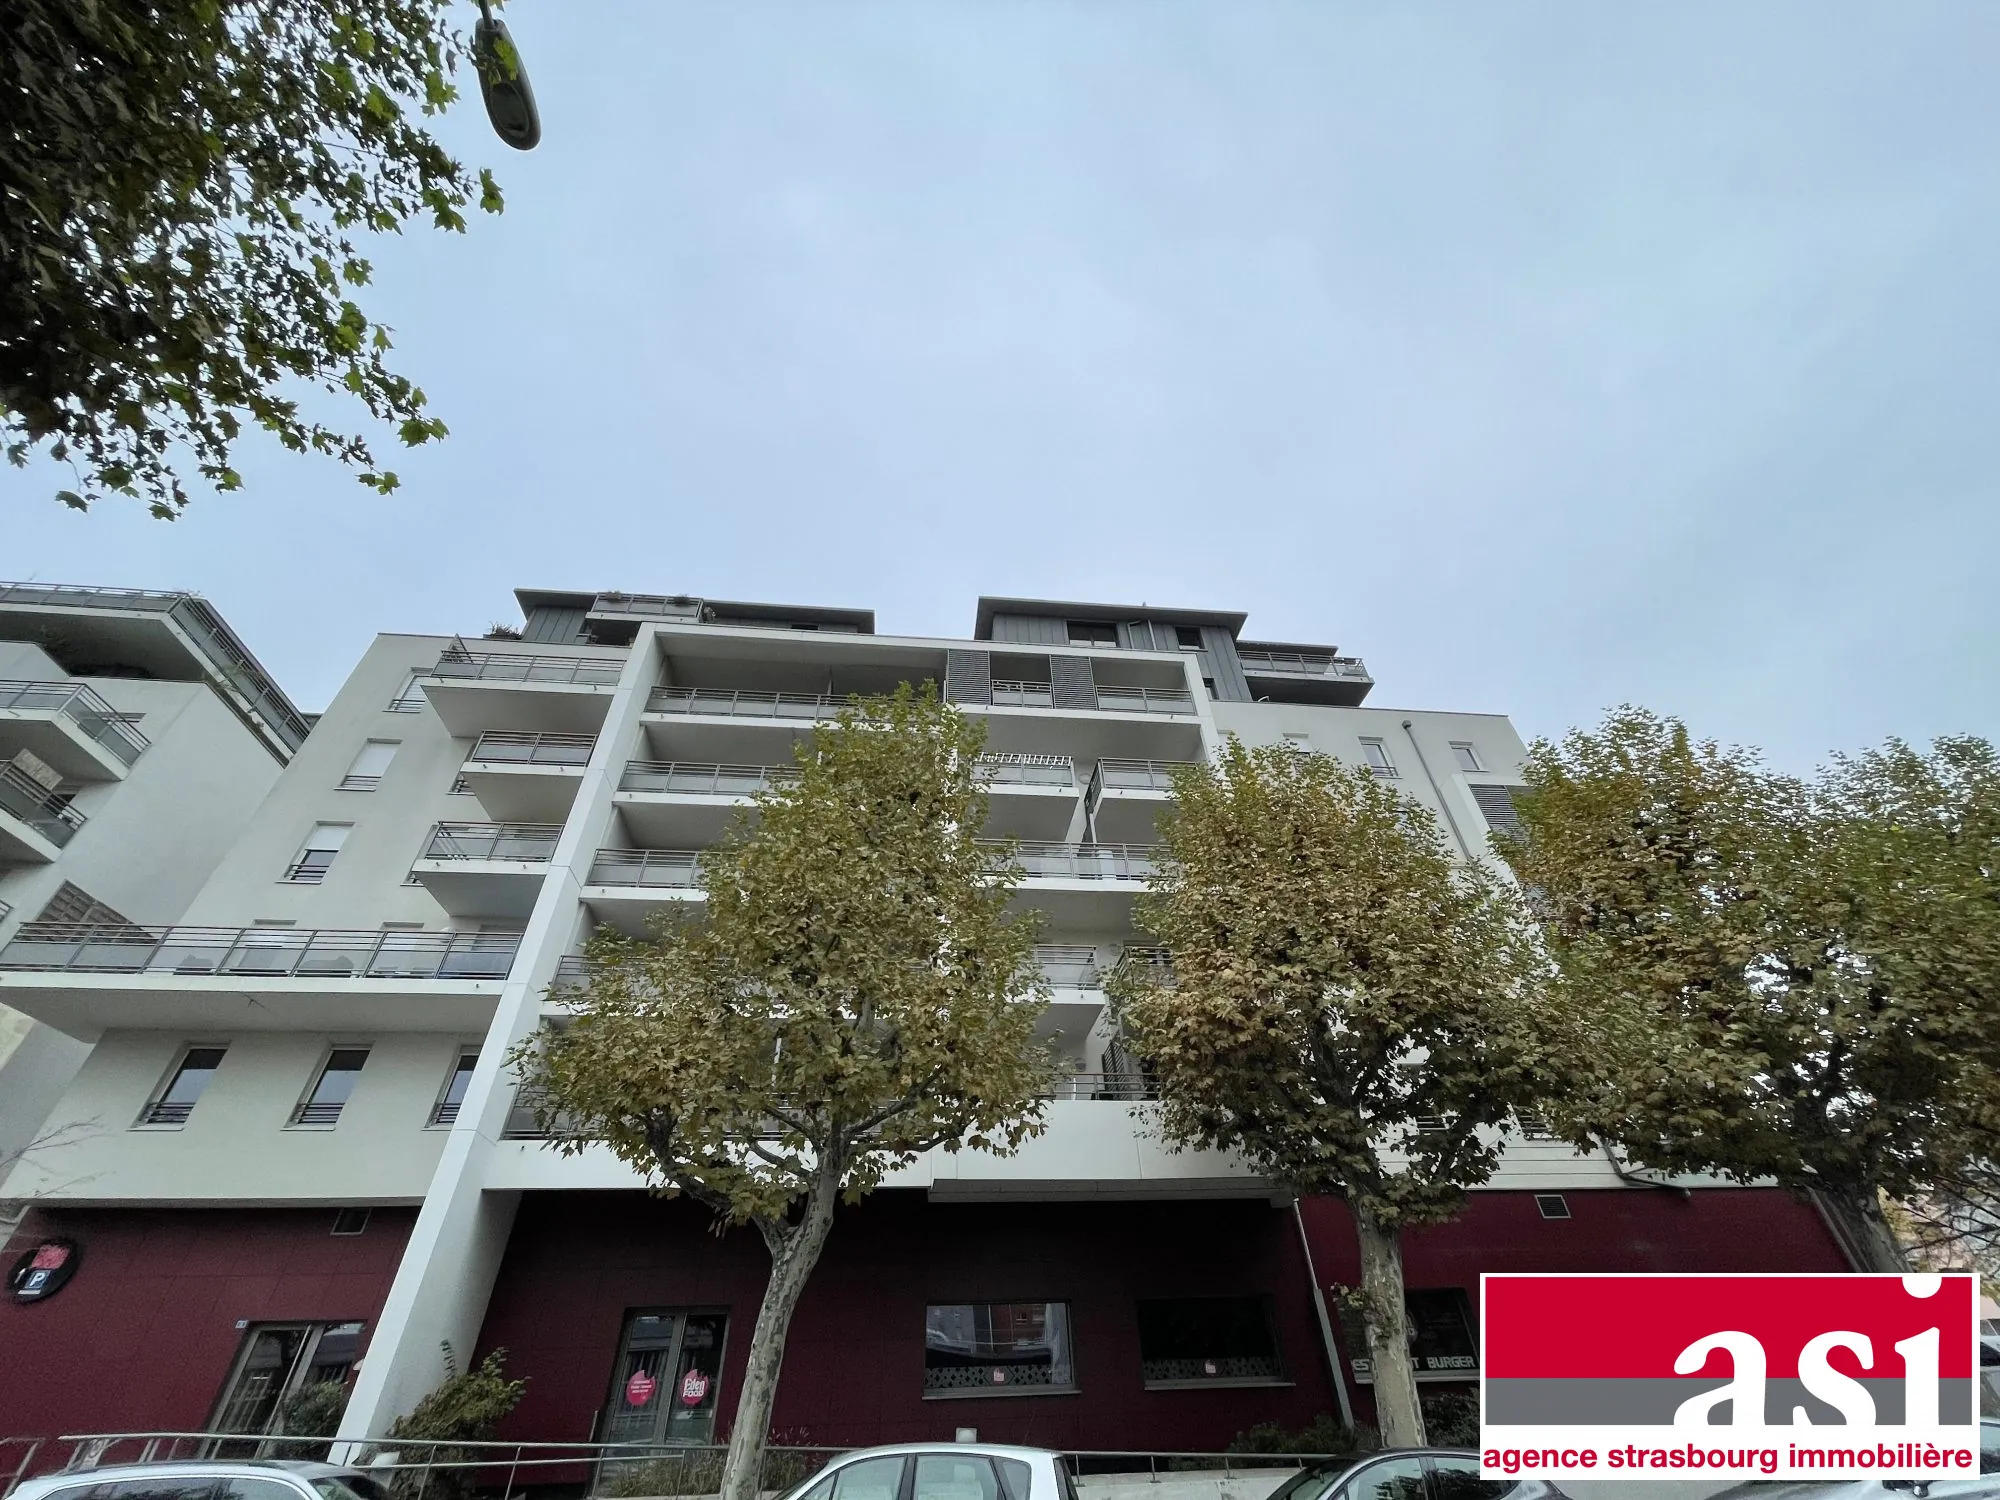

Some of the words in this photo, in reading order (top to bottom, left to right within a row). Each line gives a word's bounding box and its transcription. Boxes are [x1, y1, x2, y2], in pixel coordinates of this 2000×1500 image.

[29, 1272, 46, 1287] P
[1426, 1356, 1476, 1369] BURGER
[685, 1378, 705, 1391] Eden
[682, 1390, 704, 1398] FOOD
